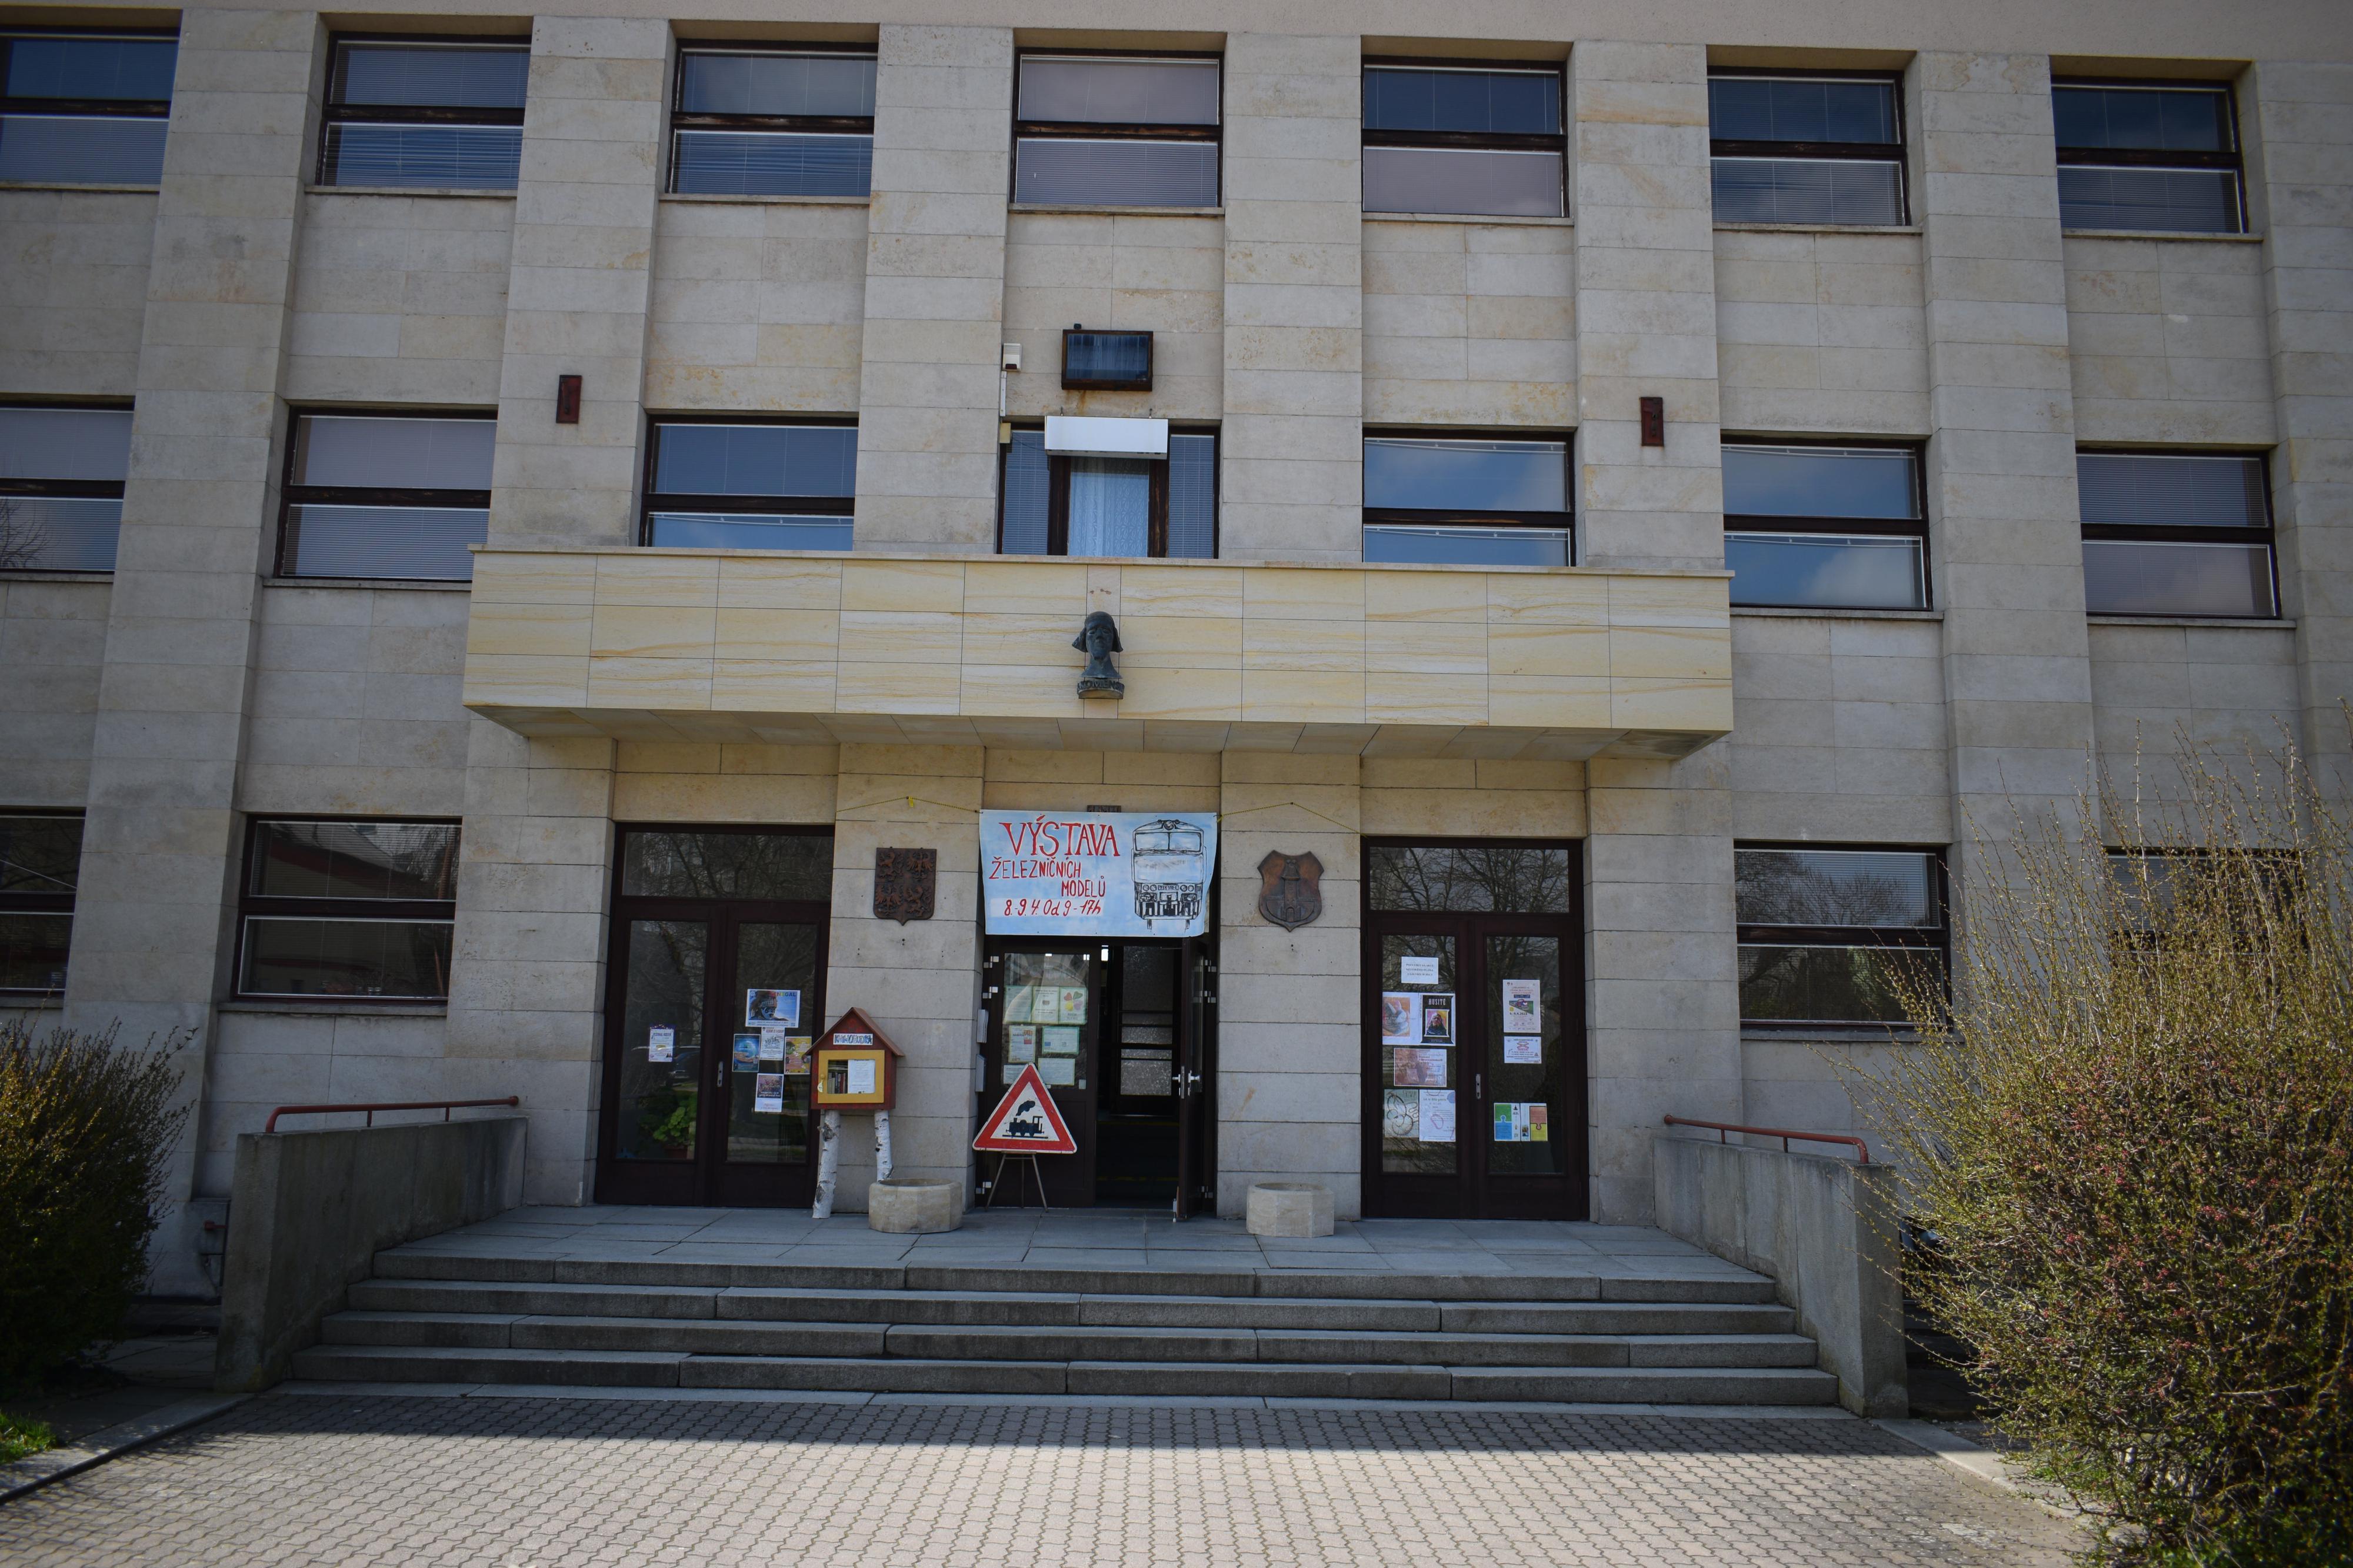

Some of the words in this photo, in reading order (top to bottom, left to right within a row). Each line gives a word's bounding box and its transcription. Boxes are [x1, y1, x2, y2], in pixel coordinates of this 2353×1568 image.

[999, 815, 1121, 857] VÝSTAVA
[1061, 875, 1106, 898] MODELŮ
[1044, 899, 1061, 916] Od
